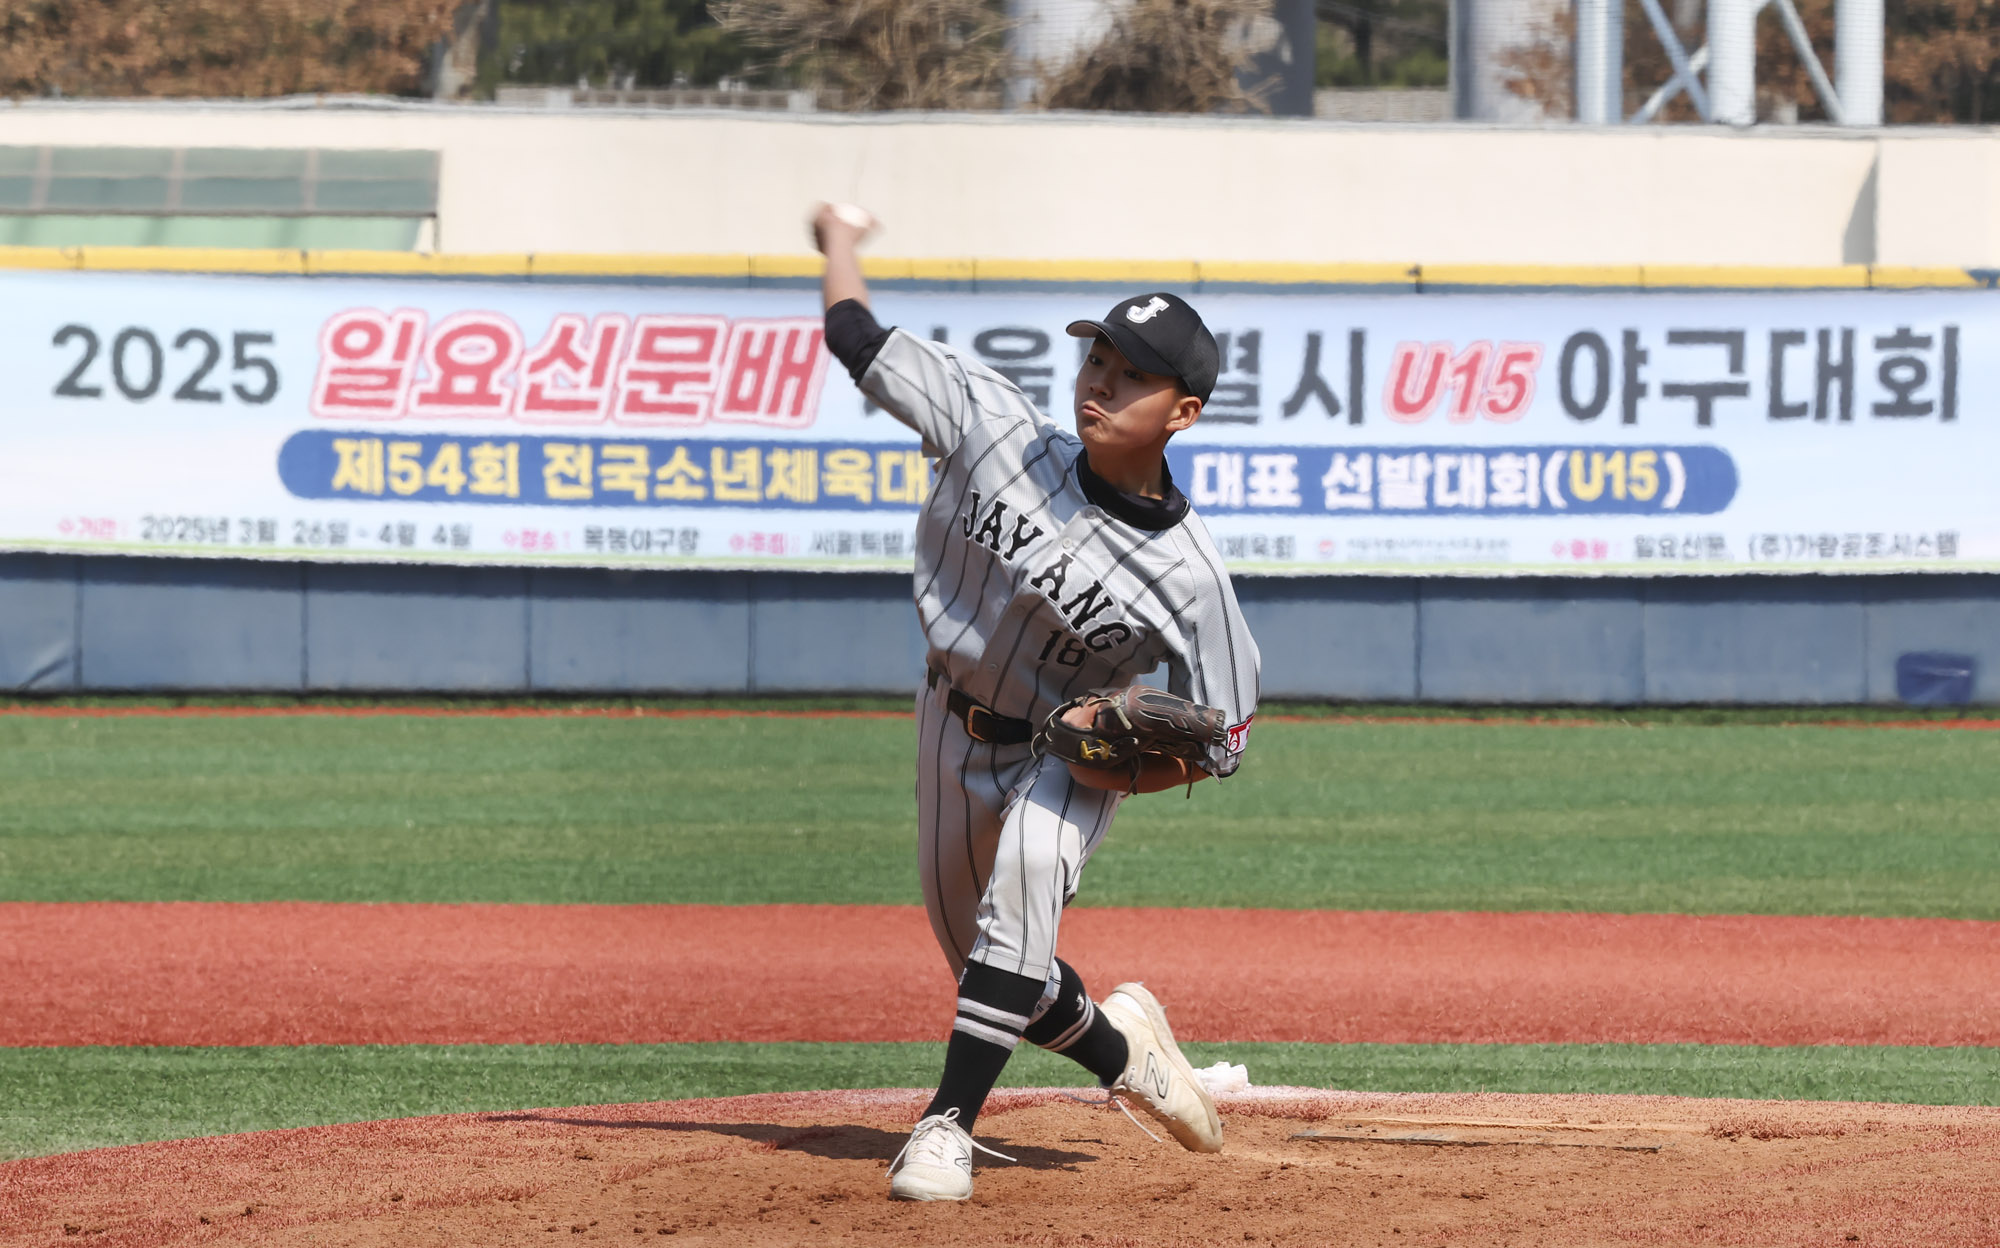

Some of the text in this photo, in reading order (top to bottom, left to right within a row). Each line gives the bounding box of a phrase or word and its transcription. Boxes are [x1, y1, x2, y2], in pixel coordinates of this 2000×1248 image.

[1126, 295, 1170, 324] J
[51, 323, 281, 404] 2025
[312, 309, 830, 427] 일요신문배
[1383, 341, 1545, 424] U15
[1558, 325, 1960, 427] 야구대회
[332, 439, 1686, 510] 제54회 전국소년체육대 대표 선발대회(U15)
[140, 514, 229, 543] 2025년
[292, 518, 350, 547] 26일
[583, 524, 699, 556] 목동야구장
[808, 528, 916, 558] 서울특별
[963, 489, 1133, 654] JAYANG
[1038, 629, 1086, 668] 18
